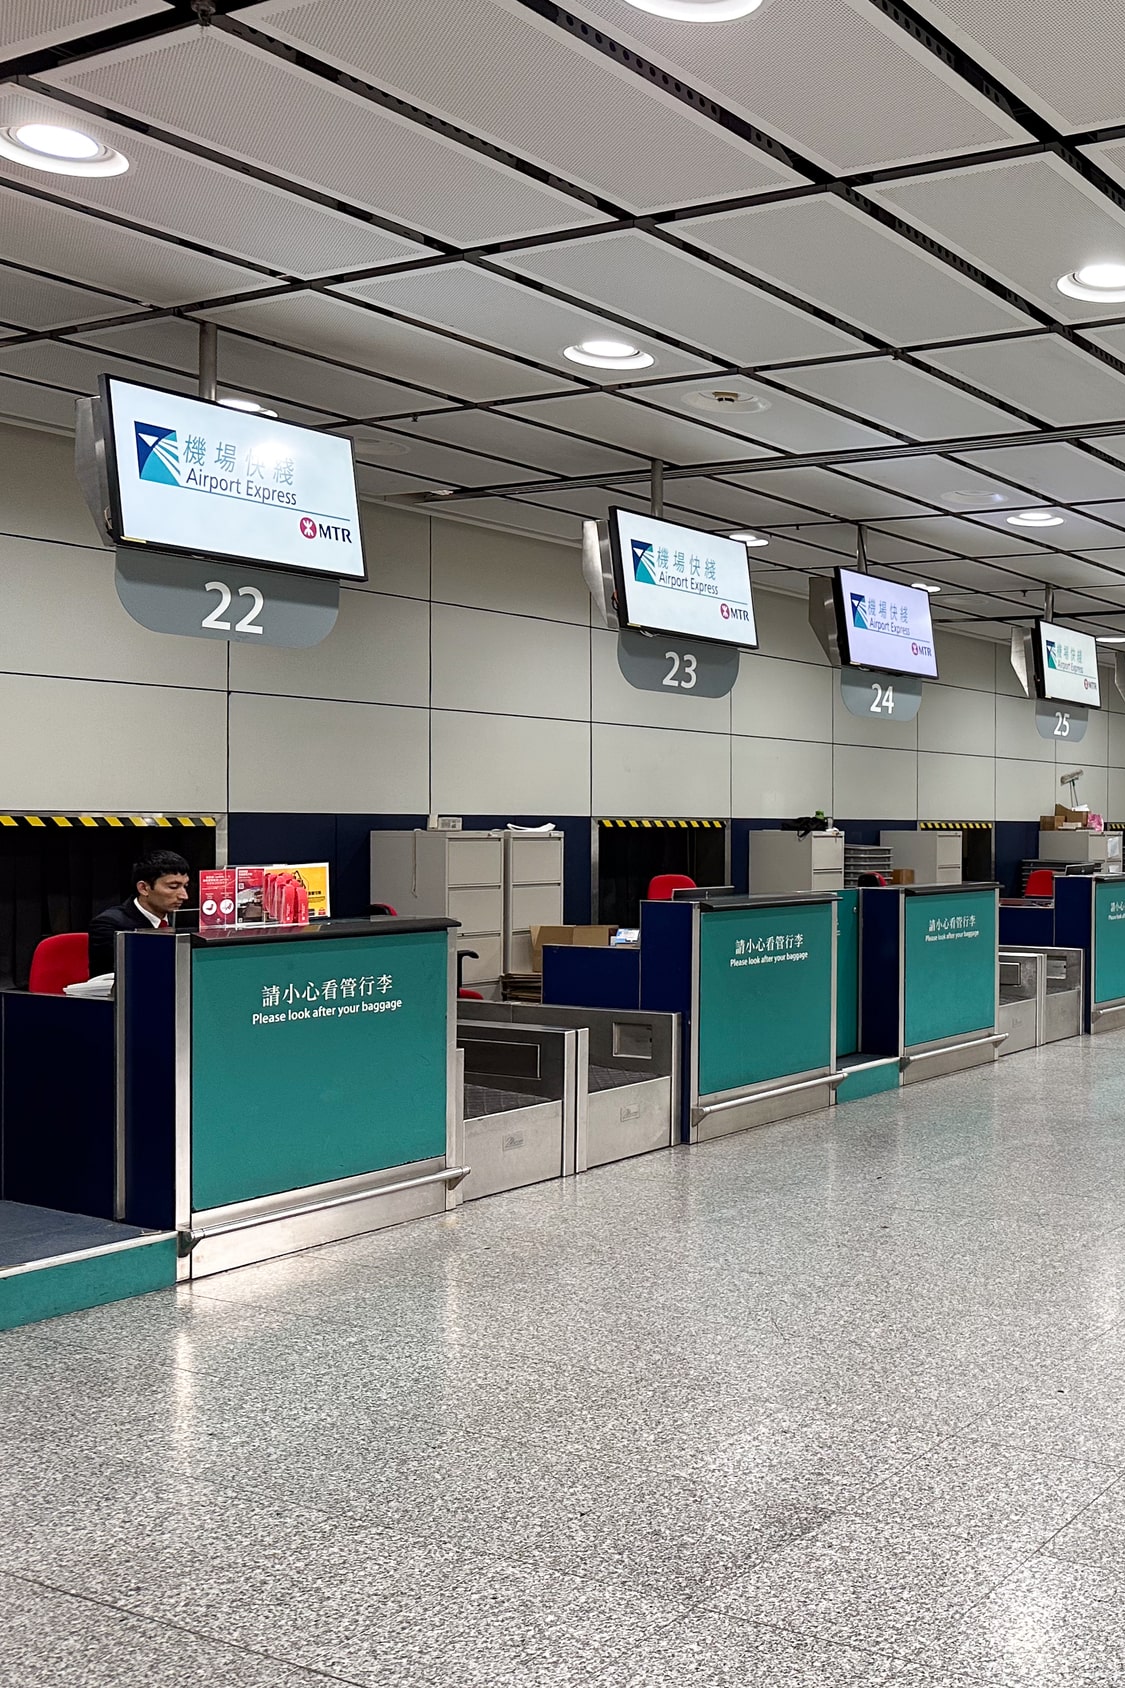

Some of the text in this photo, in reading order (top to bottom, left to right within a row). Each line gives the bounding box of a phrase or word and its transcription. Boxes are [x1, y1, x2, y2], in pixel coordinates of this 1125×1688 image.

[186, 467, 297, 505] Airport Express
[318, 523, 353, 544] MTR
[659, 571, 719, 595] Airport Express
[201, 581, 264, 635] 22
[730, 607, 750, 621] MTR
[869, 617, 910, 636] Airport Express
[918, 645, 932, 656] MTR
[662, 650, 698, 689] 23
[870, 683, 894, 714] 24
[1053, 712, 1070, 737] 25
[928, 914, 976, 932] 請小心看管行李
[735, 933, 803, 955] 請小心看管行李
[925, 934, 938, 942] Please
[963, 930, 979, 938] baggage
[730, 951, 808, 967] Please look after your baggage
[261, 974, 393, 1008] 請小心看管行李
[252, 998, 402, 1025] Please look after your baggage
